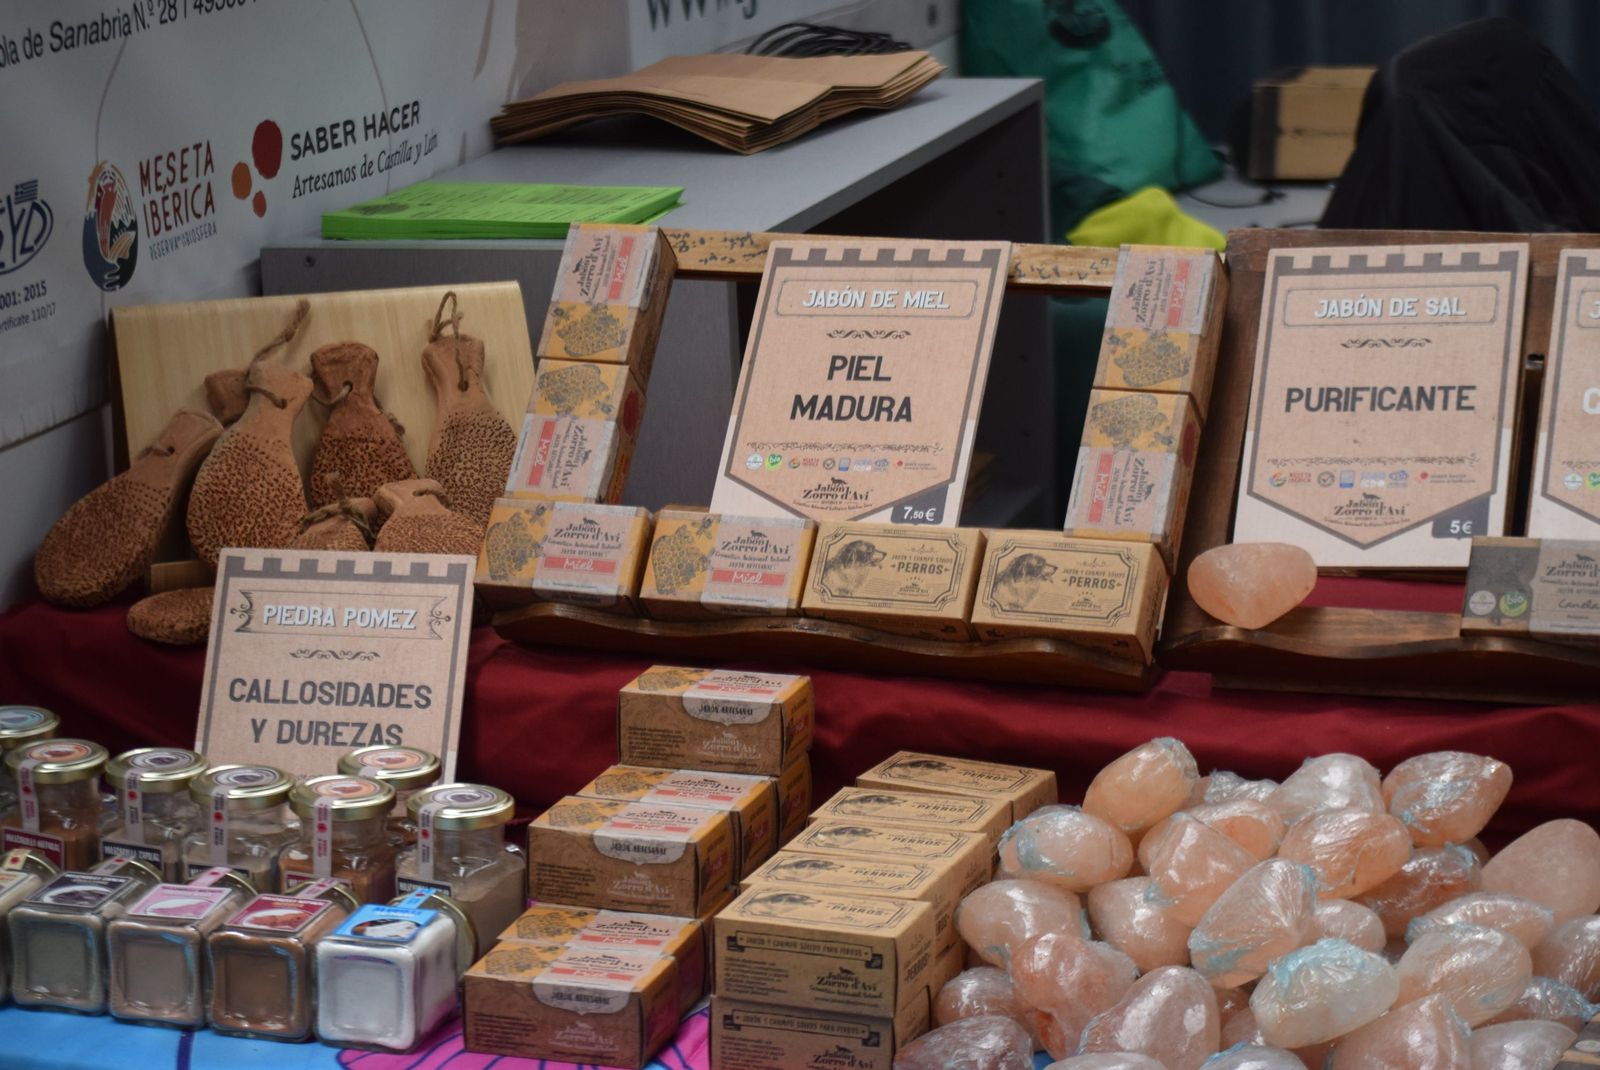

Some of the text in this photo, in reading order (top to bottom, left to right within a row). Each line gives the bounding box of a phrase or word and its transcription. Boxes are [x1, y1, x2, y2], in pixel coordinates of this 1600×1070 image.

[22, 27, 43, 60] de
[49, 8, 132, 53] Sanabria
[159, 0, 178, 25] 28
[290, 100, 420, 161] SABER HACER
[139, 139, 215, 197] MESETA
[292, 164, 357, 199] Artesanos
[360, 153, 374, 179] de
[377, 140, 413, 173] Castilla
[413, 143, 422, 166] y
[143, 181, 216, 238] IBÉRICA
[24, 281, 47, 302] 2015
[803, 285, 950, 310] JABÓN DE MIEL
[1314, 294, 1467, 319] JABÓN DE SAL
[826, 355, 892, 382] PIEL
[1284, 385, 1476, 413] PURIFICANTE
[789, 394, 913, 423] MADURA
[802, 489, 838, 500] Zorro
[1334, 506, 1372, 516] Zorro
[553, 528, 593, 540] Zorro
[721, 541, 758, 552] Zorro
[563, 558, 594, 571] Miel
[897, 562, 944, 575] PERROS
[732, 571, 763, 584] Miel
[1545, 566, 1587, 577] Zorro
[1068, 576, 1116, 590] PERROS
[263, 603, 418, 631] PIEDRA POMEZ
[228, 677, 432, 710] CALLOSIDADES
[250, 718, 404, 748] Y DUREZAS
[962, 770, 1009, 782] PERROS
[916, 803, 965, 813] PERROS
[893, 836, 941, 847] PERROS
[855, 869, 905, 879] PERROS
[832, 904, 884, 916] PERROS
[815, 976, 850, 989] Zorro
[812, 1054, 847, 1067] Zorro
